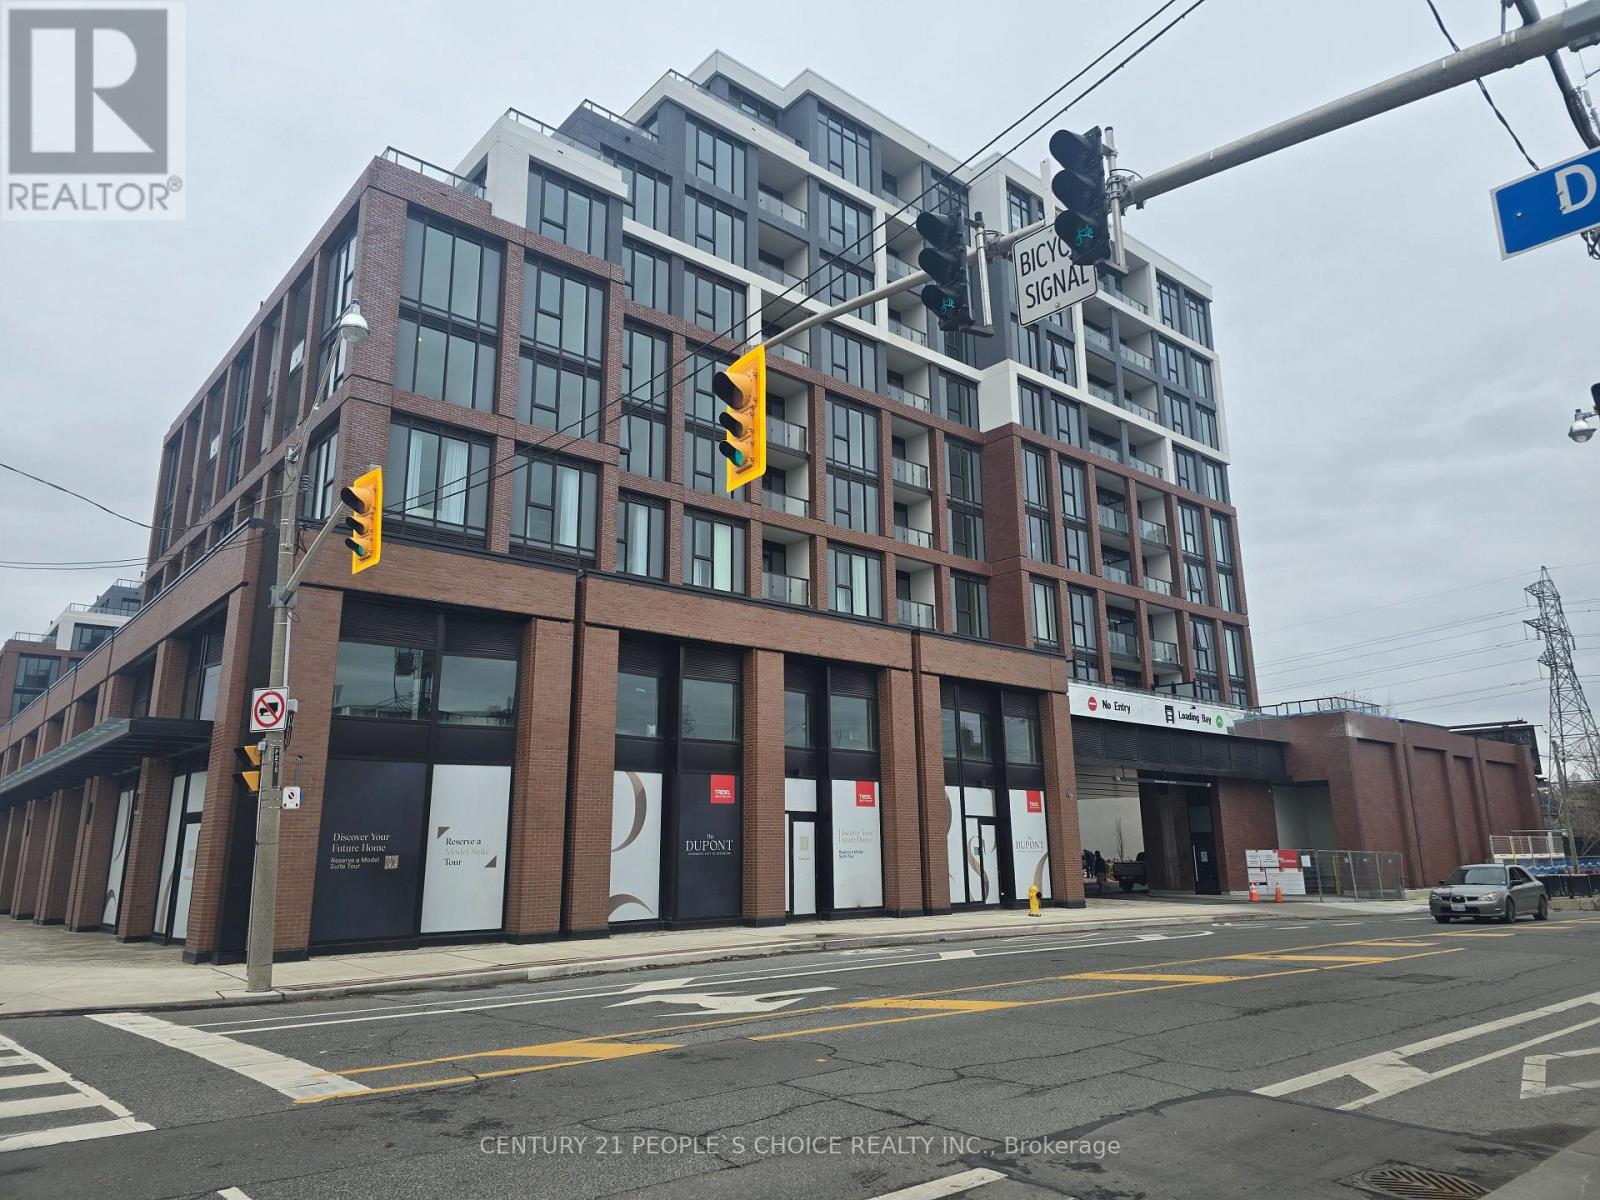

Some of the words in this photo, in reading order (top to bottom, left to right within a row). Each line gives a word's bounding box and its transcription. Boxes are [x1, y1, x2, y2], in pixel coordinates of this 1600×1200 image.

[1019, 236, 1070, 277] BICYC
[1025, 264, 1090, 309] SIGNAL
[1102, 699, 1112, 710] No
[1114, 701, 1131, 714] Entry
[1178, 710, 1200, 724] Loading
[1201, 713, 1212, 725] Bay
[333, 832, 369, 842] Discover
[371, 832, 391, 841] Your
[446, 837, 475, 846] Reserve
[332, 843, 360, 853] Future
[361, 843, 386, 852] Home
[686, 840, 734, 851] DUPONT
[1016, 841, 1044, 849] DUPONT
[444, 858, 462, 866] Tour
